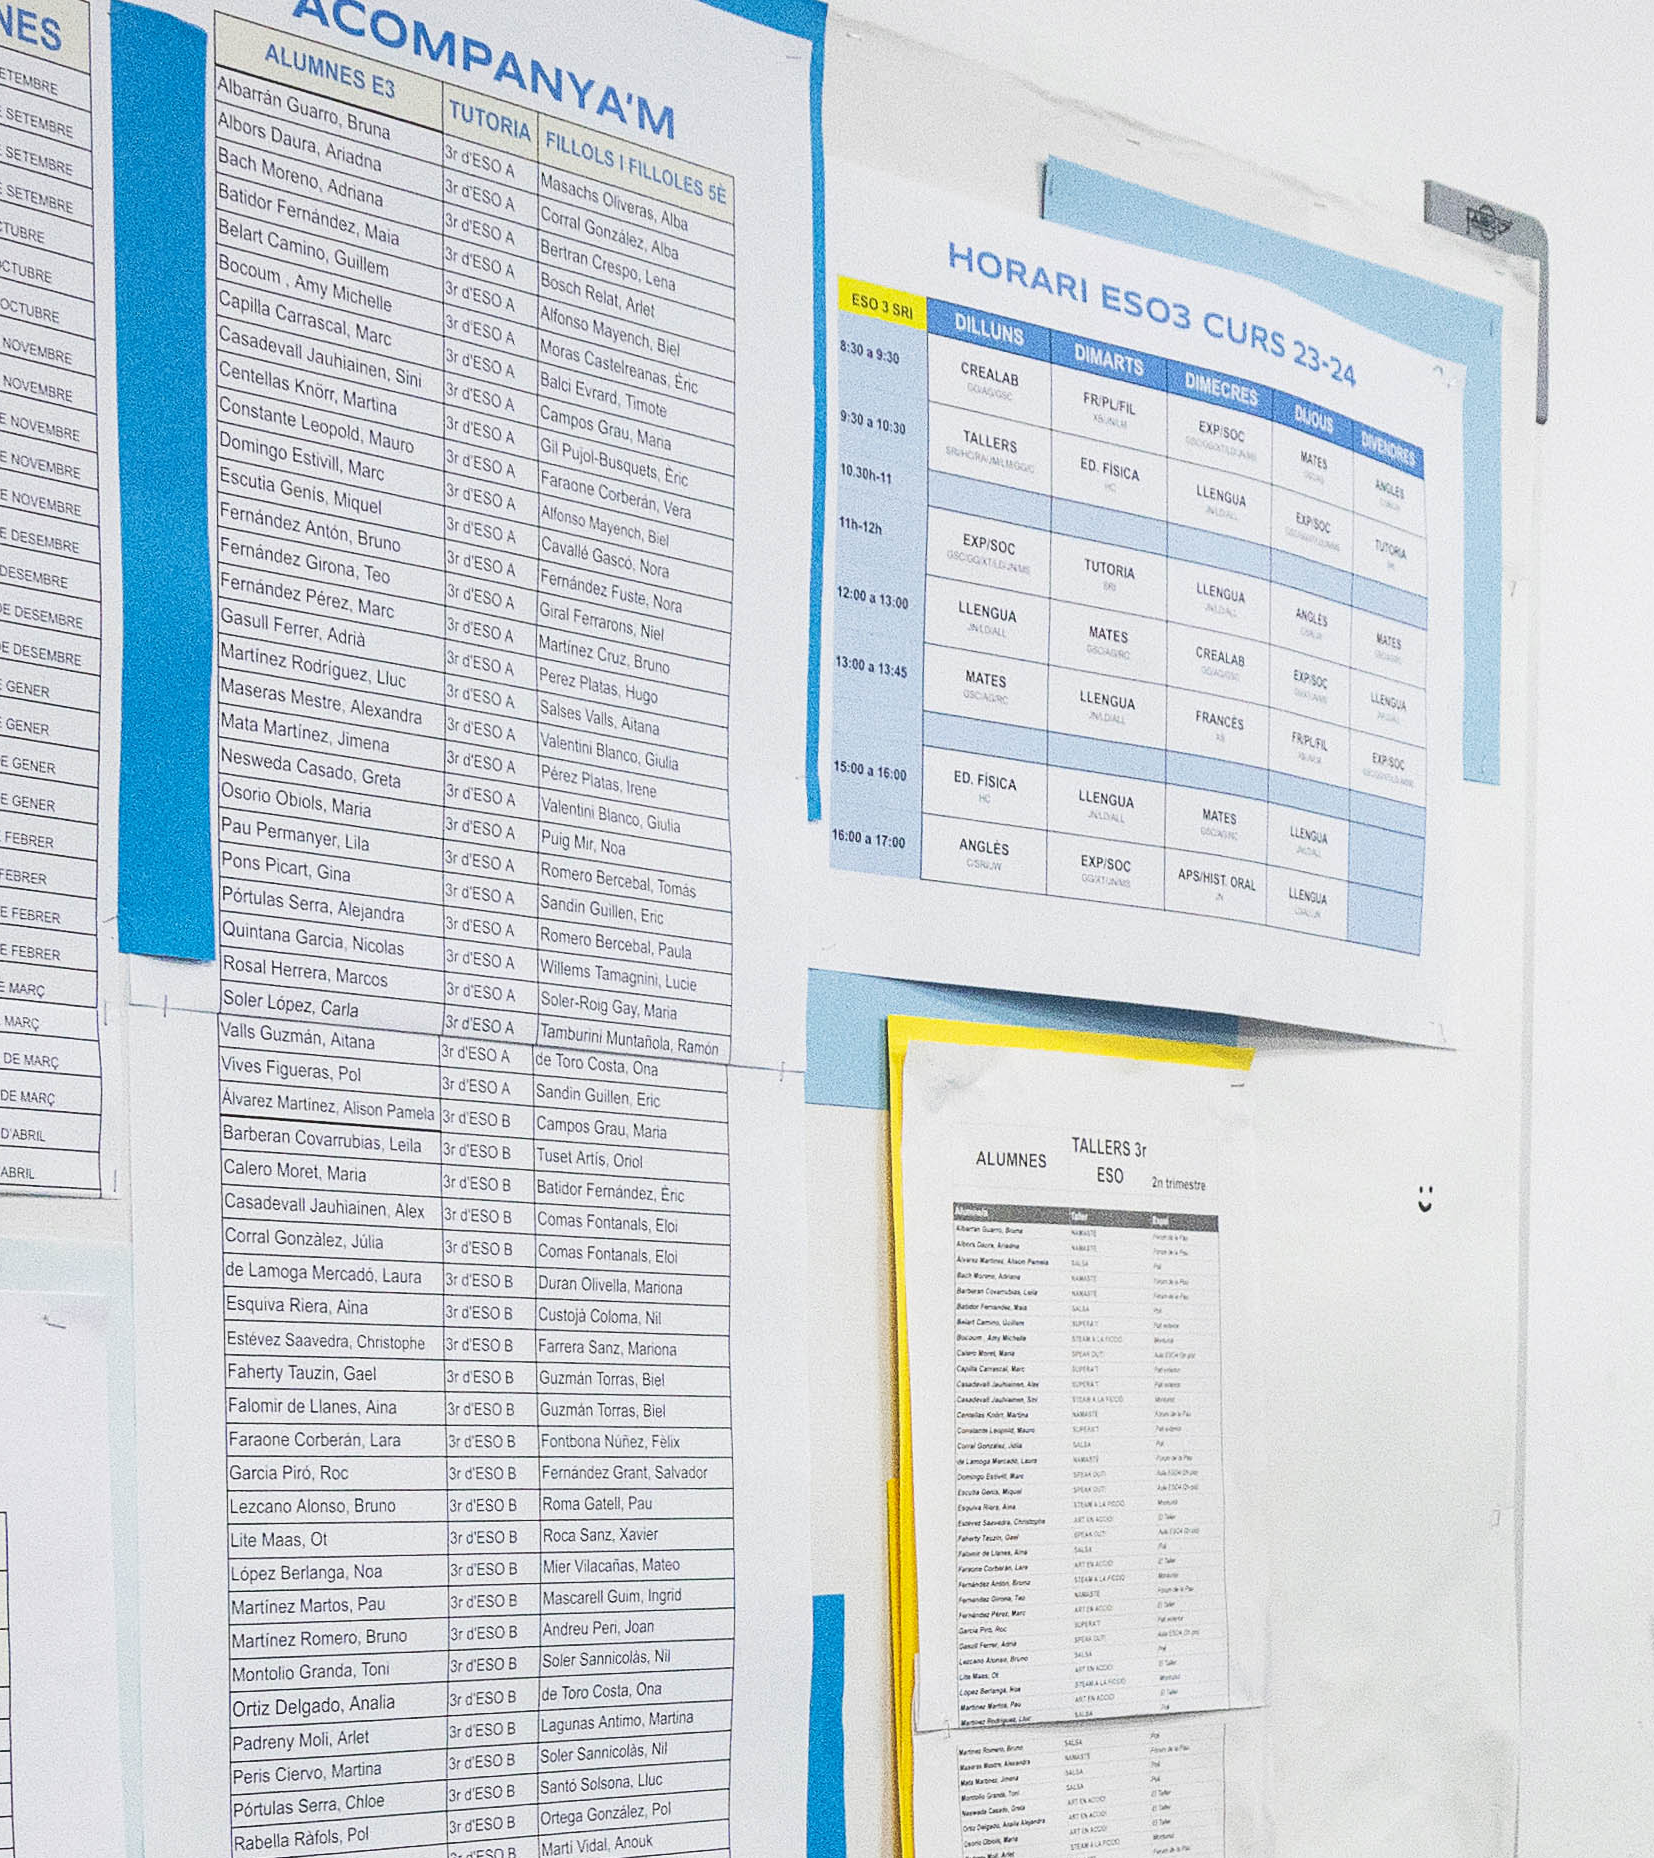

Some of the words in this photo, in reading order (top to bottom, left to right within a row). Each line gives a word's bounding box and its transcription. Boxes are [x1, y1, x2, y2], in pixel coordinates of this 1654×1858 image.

[265, 43, 365, 90] ALUMNES
[372, 74, 395, 98] E3
[218, 76, 282, 109] Albarrán
[286, 96, 342, 127] Guarro,
[347, 113, 390, 140] Bruna
[449, 101, 530, 141] TUTORIA
[445, 146, 458, 163] 3r
[461, 150, 501, 177] d'ESO
[505, 162, 515, 177] A
[546, 131, 615, 168] FILLOLS
[620, 153, 625, 169] I
[628, 156, 704, 198] FILLOLES
[541, 173, 599, 204] Masachs
[603, 189, 657, 223] Oliveras,
[661, 208, 688, 231] Alba
[852, 292, 878, 312] ESO
[882, 299, 889, 314] 3
[893, 301, 914, 321] SRI
[949, 241, 1088, 303] HORARI
[1102, 285, 1190, 330] ESO3
[1204, 312, 1285, 358] CURS
[1292, 339, 1357, 389] 23-24
[955, 311, 1025, 348] DILLUNS
[840, 340, 864, 356] 8:30
[866, 349, 874, 358] a
[876, 349, 899, 364] 9:30
[1074, 341, 1144, 377] DIMARTS
[961, 361, 1018, 387] CREALAB
[1084, 391, 1136, 416] FR/PL/FIL
[840, 410, 864, 426] 9:30
[866, 418, 874, 428] a
[877, 418, 906, 435] 10:30
[1295, 403, 1333, 436] DIJOUS
[964, 430, 1017, 453] TALLERS
[1199, 420, 1245, 442] EXP/SOC
[1361, 428, 1416, 468] DIVENDRES
[1080, 457, 1098, 472] ED.
[1300, 451, 1328, 470] MATES
[841, 462, 892, 485] 10.30h-11
[1196, 484, 1246, 507] LLENGUA
[839, 516, 882, 535] 11h-12h
[963, 533, 1016, 556] EXP/SOC
[1375, 539, 1407, 560] TUTORIA
[1084, 558, 1135, 579] TUTORIA
[837, 586, 866, 602] 12:00
[870, 594, 877, 604] a
[880, 594, 909, 610] 13:00
[959, 601, 1017, 623] LLENGUA
[1089, 625, 1128, 643] MATES
[836, 655, 865, 672] 13:00
[868, 664, 875, 673] a
[878, 663, 908, 678] 13:45
[1196, 646, 1245, 667] CREALAB
[965, 670, 1006, 688] MATES
[1080, 690, 1136, 710] LLENGUA
[833, 759, 864, 775] 15:00
[867, 766, 874, 777] a
[878, 765, 907, 782] 16:00
[954, 770, 974, 785] ED.
[1079, 789, 1135, 809] LLENGUA
[831, 828, 862, 844] 16:00
[865, 834, 872, 845] a
[875, 833, 905, 850] 17:00
[1290, 826, 1328, 844] LLENGUA
[1081, 855, 1131, 873] EXP/SOC
[1230, 874, 1256, 892] ORAL
[1073, 1137, 1130, 1157] TALLERS
[1134, 1142, 1146, 1158] 3r
[976, 1151, 1046, 1168] ALUMNES
[1097, 1167, 1124, 1184] ESO
[1152, 1177, 1163, 1188] 2n
[1165, 1177, 1206, 1191] trimestre
[229, 1499, 292, 1514] Lezcano
[295, 1498, 351, 1516] Alonso,
[355, 1498, 396, 1513] Bruno
[448, 1498, 463, 1512] 3r
[465, 1497, 505, 1512] d'ESO
[507, 1498, 517, 1511] B
[543, 1496, 579, 1511] Roma
[581, 1496, 626, 1512] Gatell,
[629, 1496, 653, 1510] Pau
